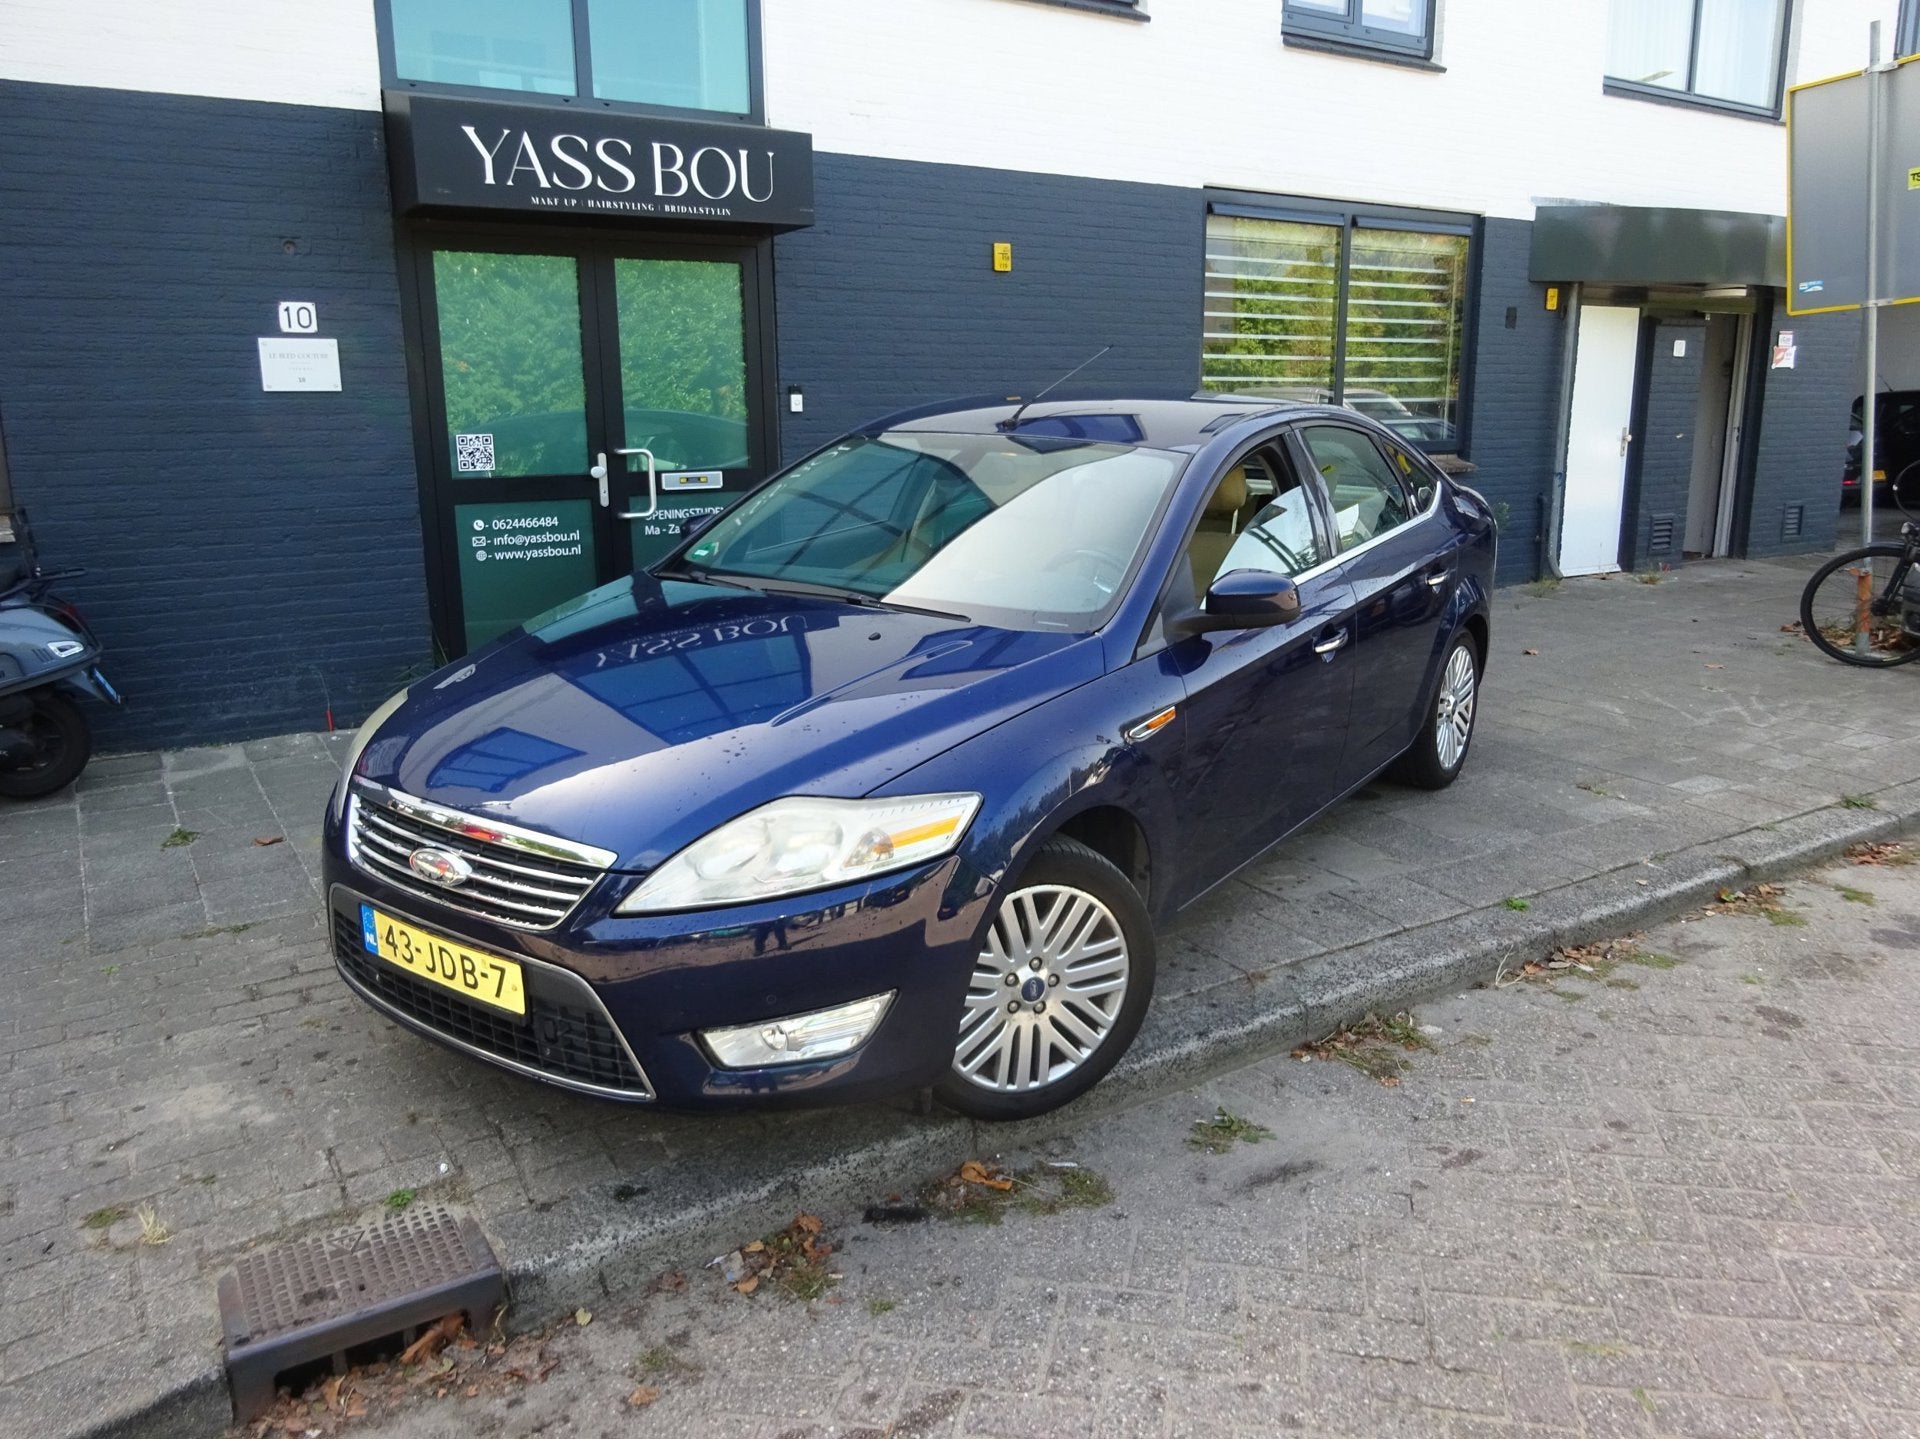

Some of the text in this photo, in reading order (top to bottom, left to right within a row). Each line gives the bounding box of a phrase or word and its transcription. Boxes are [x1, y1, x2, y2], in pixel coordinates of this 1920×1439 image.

[461, 125, 775, 203] YASS BOU
[564, 197, 578, 207] UP
[587, 199, 655, 212] HAIRSTYLING
[284, 306, 312, 329] 10
[492, 516, 559, 530] 0624466484
[645, 525, 660, 536] Ma
[668, 523, 681, 534] Za
[493, 529, 580, 547] info@yassbou.nl
[494, 544, 582, 561] www.yassbou.nl
[365, 931, 377, 946] NL
[384, 923, 507, 999] 43-JDB-7
